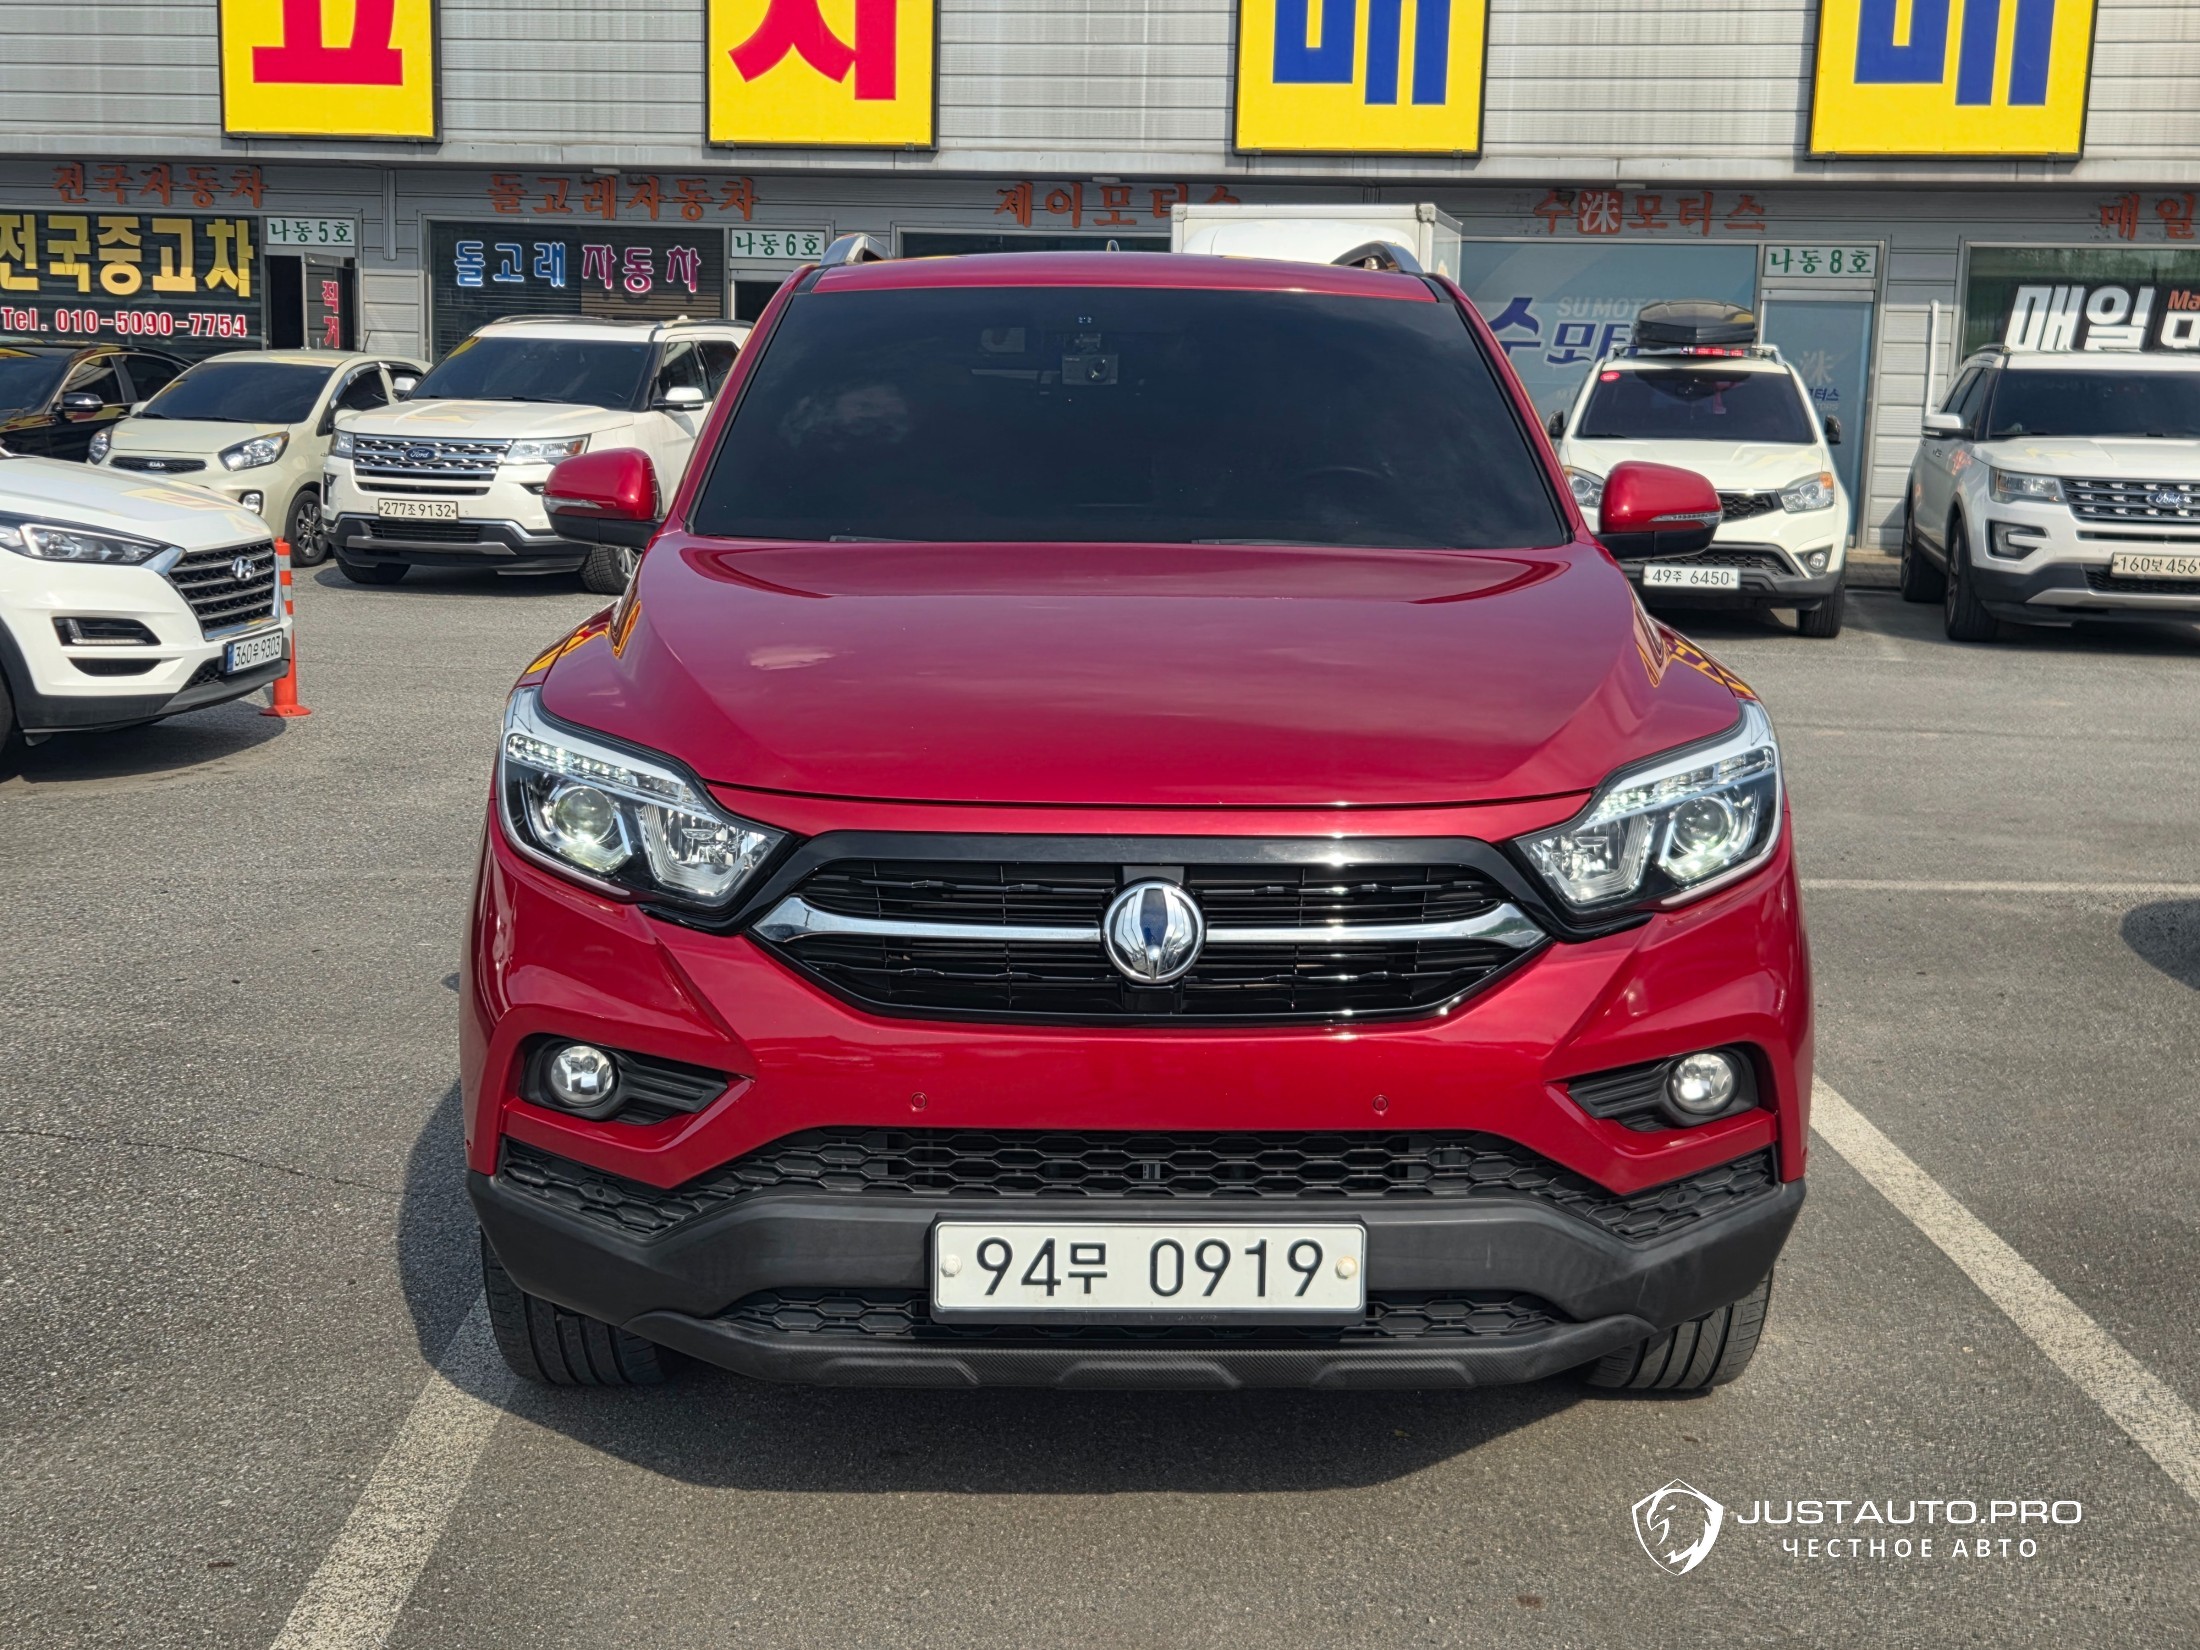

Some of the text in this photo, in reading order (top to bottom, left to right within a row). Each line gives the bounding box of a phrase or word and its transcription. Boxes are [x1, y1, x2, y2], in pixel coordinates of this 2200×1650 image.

[52, 161, 269, 209] 전국자동차
[0, 213, 254, 298] 전국중고차
[1591, 297, 1660, 319] MOT
[1, 307, 248, 338] Tel. 010-5090-7754
[410, 449, 430, 458] Ford
[418, 503, 452, 518] 9132
[2166, 558, 2200, 574] 456
[1689, 570, 1730, 585] 6450
[976, 1236, 1324, 1297] 94무 0919
